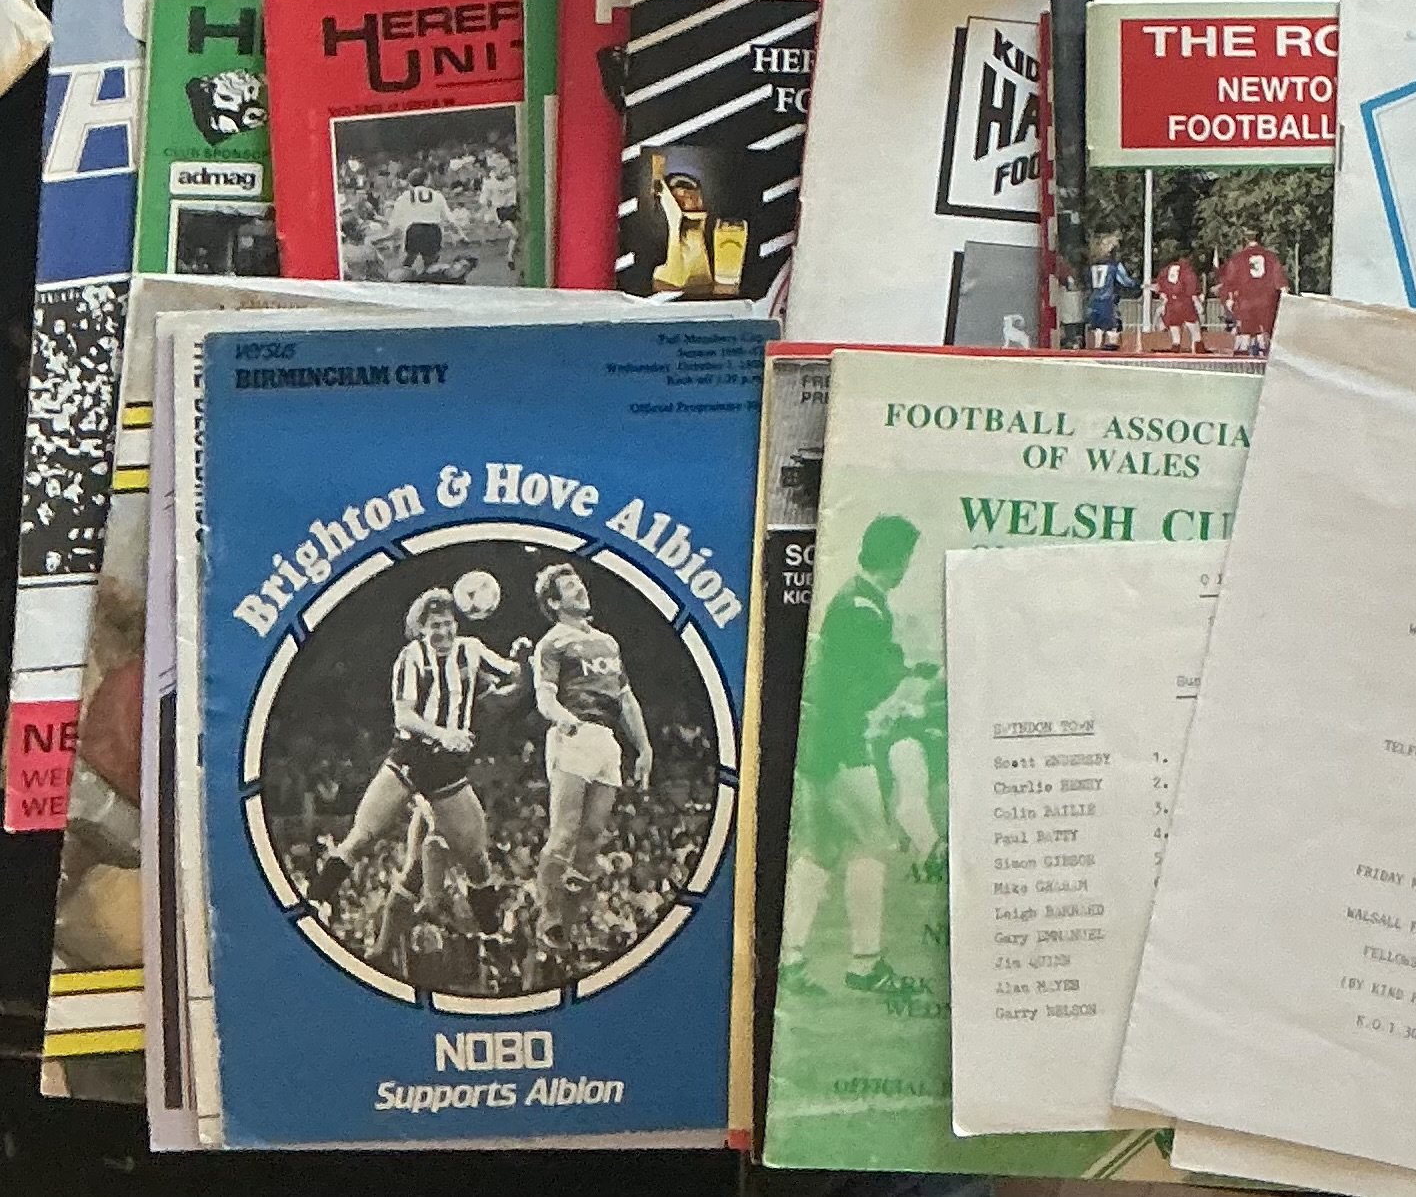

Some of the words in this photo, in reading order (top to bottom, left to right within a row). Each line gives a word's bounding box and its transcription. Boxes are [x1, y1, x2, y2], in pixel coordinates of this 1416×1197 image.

[1142, 24, 1257, 59] THE
[1167, 113, 1335, 143] FOOTBALL
[177, 168, 257, 192] admag
[1247, 254, 1266, 280] 3
[235, 363, 390, 389] BIRMINGHAM
[394, 362, 449, 387] CITY
[884, 402, 1076, 437] FOOTBALL
[1022, 443, 1069, 470] OF
[1086, 448, 1201, 479] WALES
[960, 495, 1138, 541] WELSH
[232, 482, 426, 639] Brighton
[436, 463, 473, 508] &
[482, 462, 601, 517] Hove
[604, 497, 744, 630] Albion
[993, 781, 1054, 796] Charlie
[993, 805, 1037, 820] Colin
[994, 831, 1028, 845] Paul
[994, 857, 1037, 870] Simon
[1355, 863, 1404, 886] FRIDAY
[1346, 905, 1402, 931] WALSALL
[1371, 983, 1405, 1002] KIND
[995, 1006, 1039, 1021] Garry
[435, 1031, 554, 1072] NOBO
[374, 1079, 518, 1114] Supports
[524, 1076, 625, 1106] Albion
